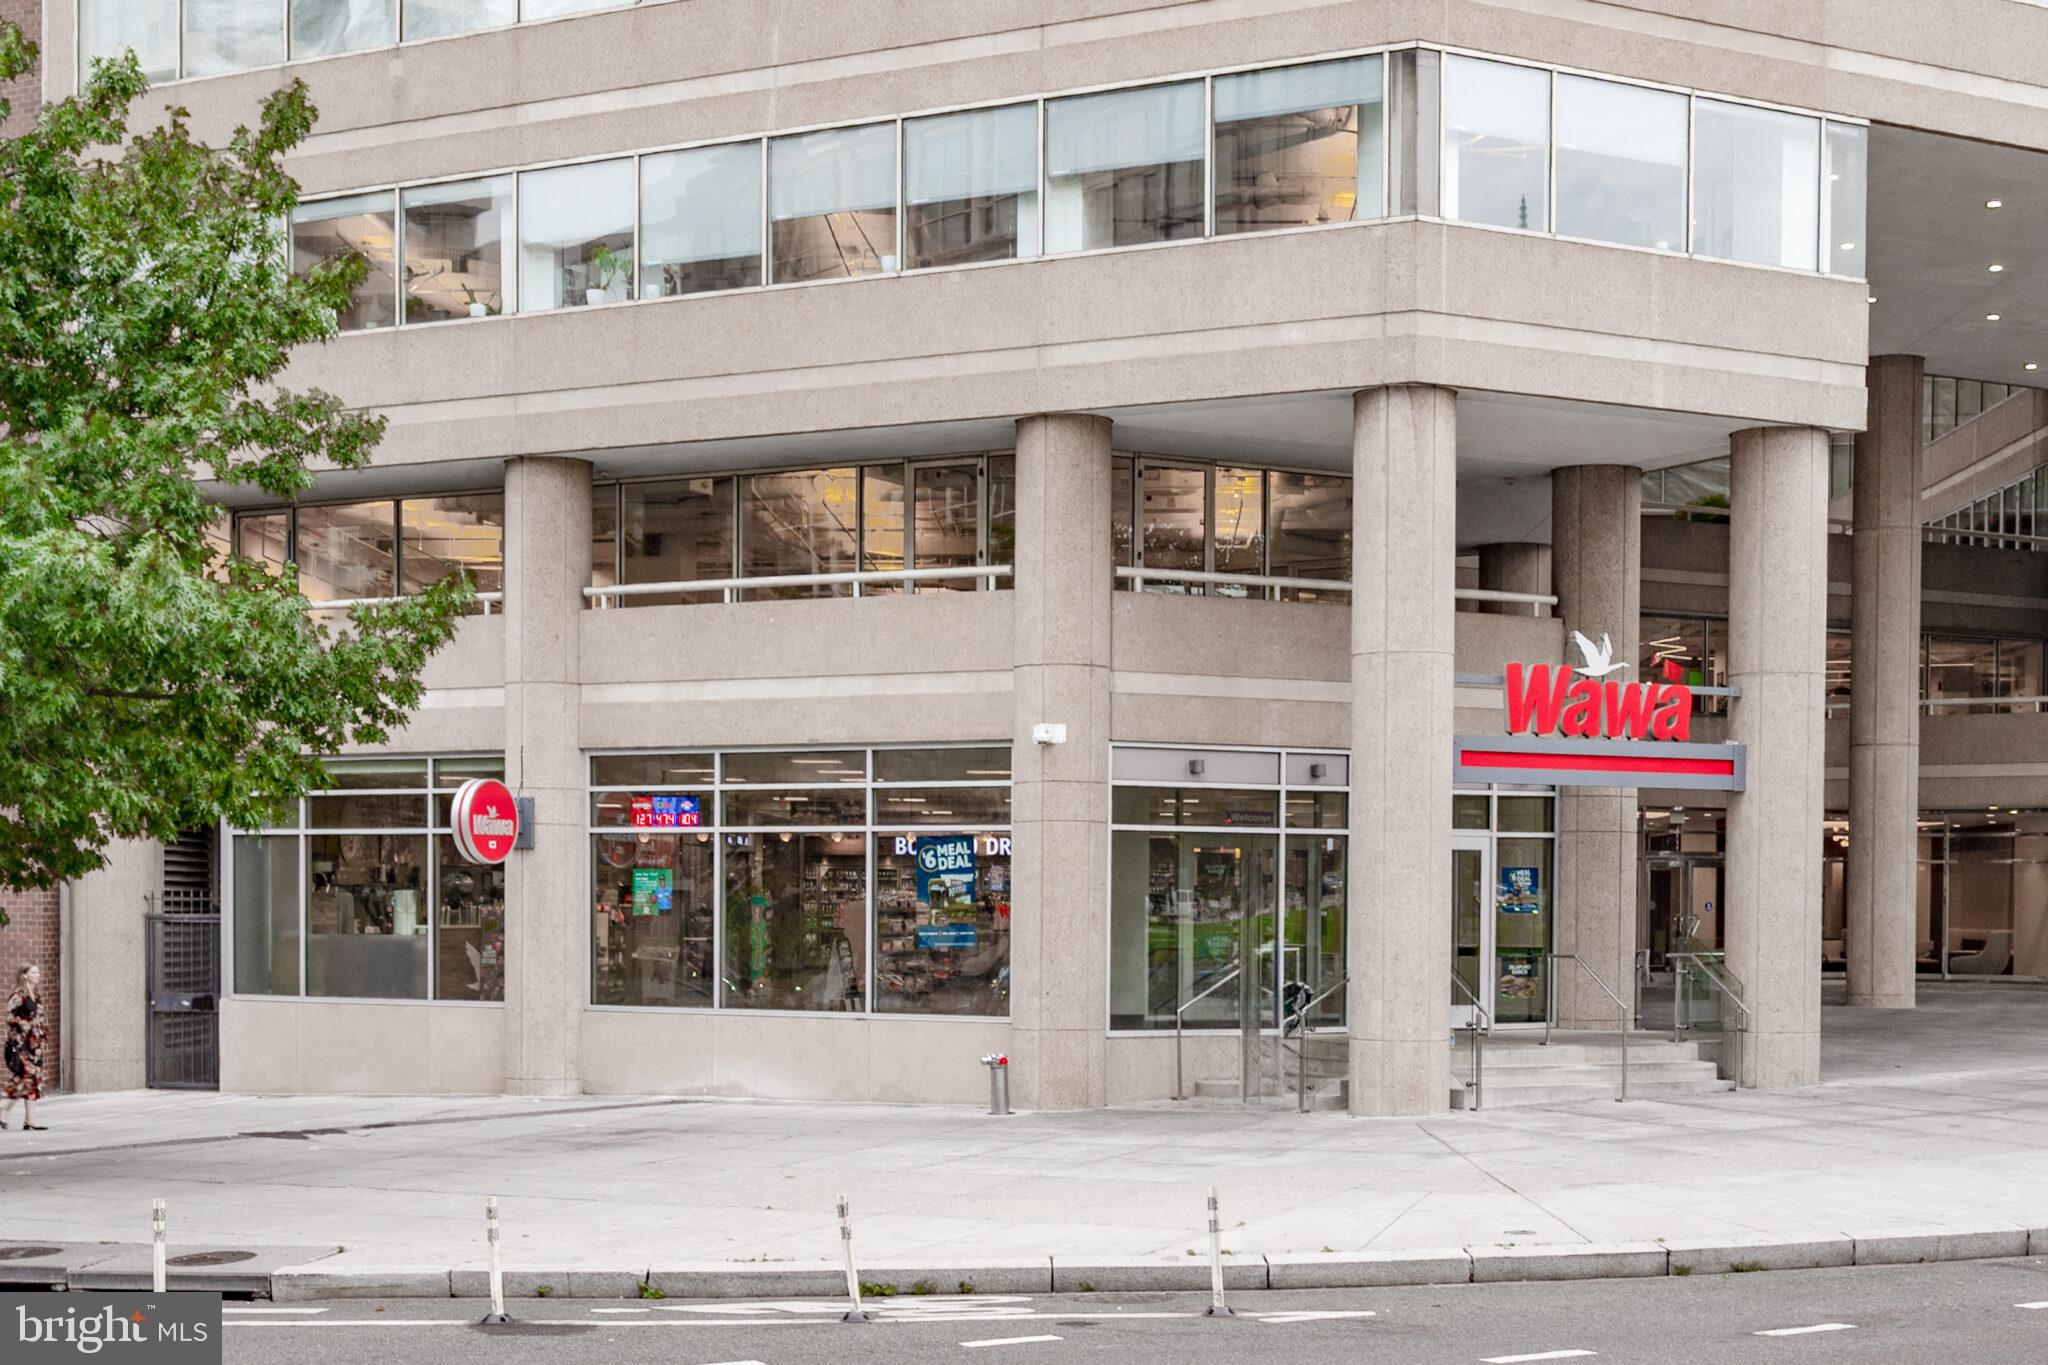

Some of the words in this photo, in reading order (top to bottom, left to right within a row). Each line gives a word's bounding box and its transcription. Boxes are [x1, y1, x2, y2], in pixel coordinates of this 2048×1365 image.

[1505, 661, 1693, 742] Wawa
[472, 813, 514, 837] Wawa
[636, 813, 653, 825] 127
[1231, 812, 1273, 823] Welcome
[936, 841, 972, 857] MEAL
[938, 855, 973, 871] DEAL
